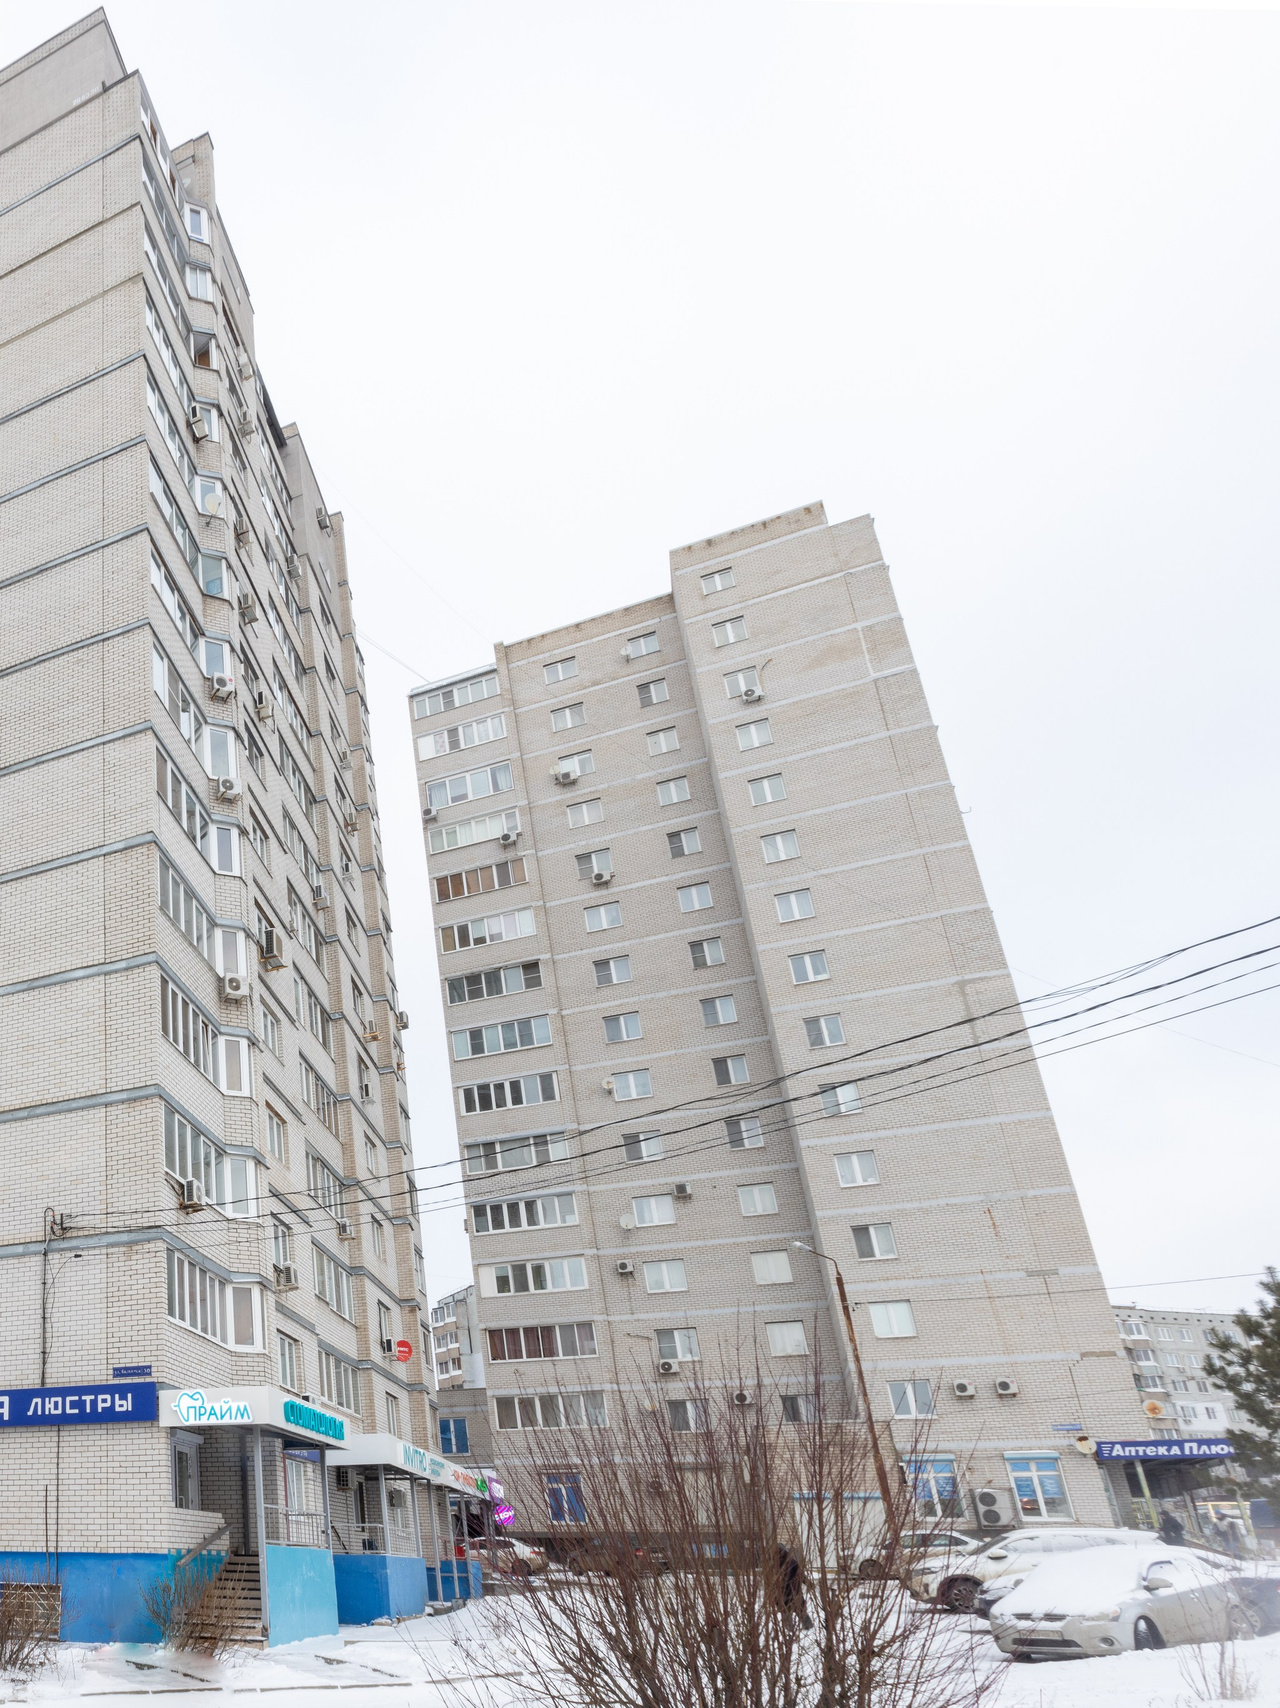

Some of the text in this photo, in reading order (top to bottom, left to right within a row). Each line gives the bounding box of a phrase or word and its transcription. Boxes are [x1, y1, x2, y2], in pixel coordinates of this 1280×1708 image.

[27, 1393, 132, 1417] ЛЮСТРЫ
[185, 1400, 251, 1422] ПРАЙМ
[283, 1399, 345, 1441] СТОМАТОЛОГИЯ
[403, 1443, 427, 1473] INVITRO
